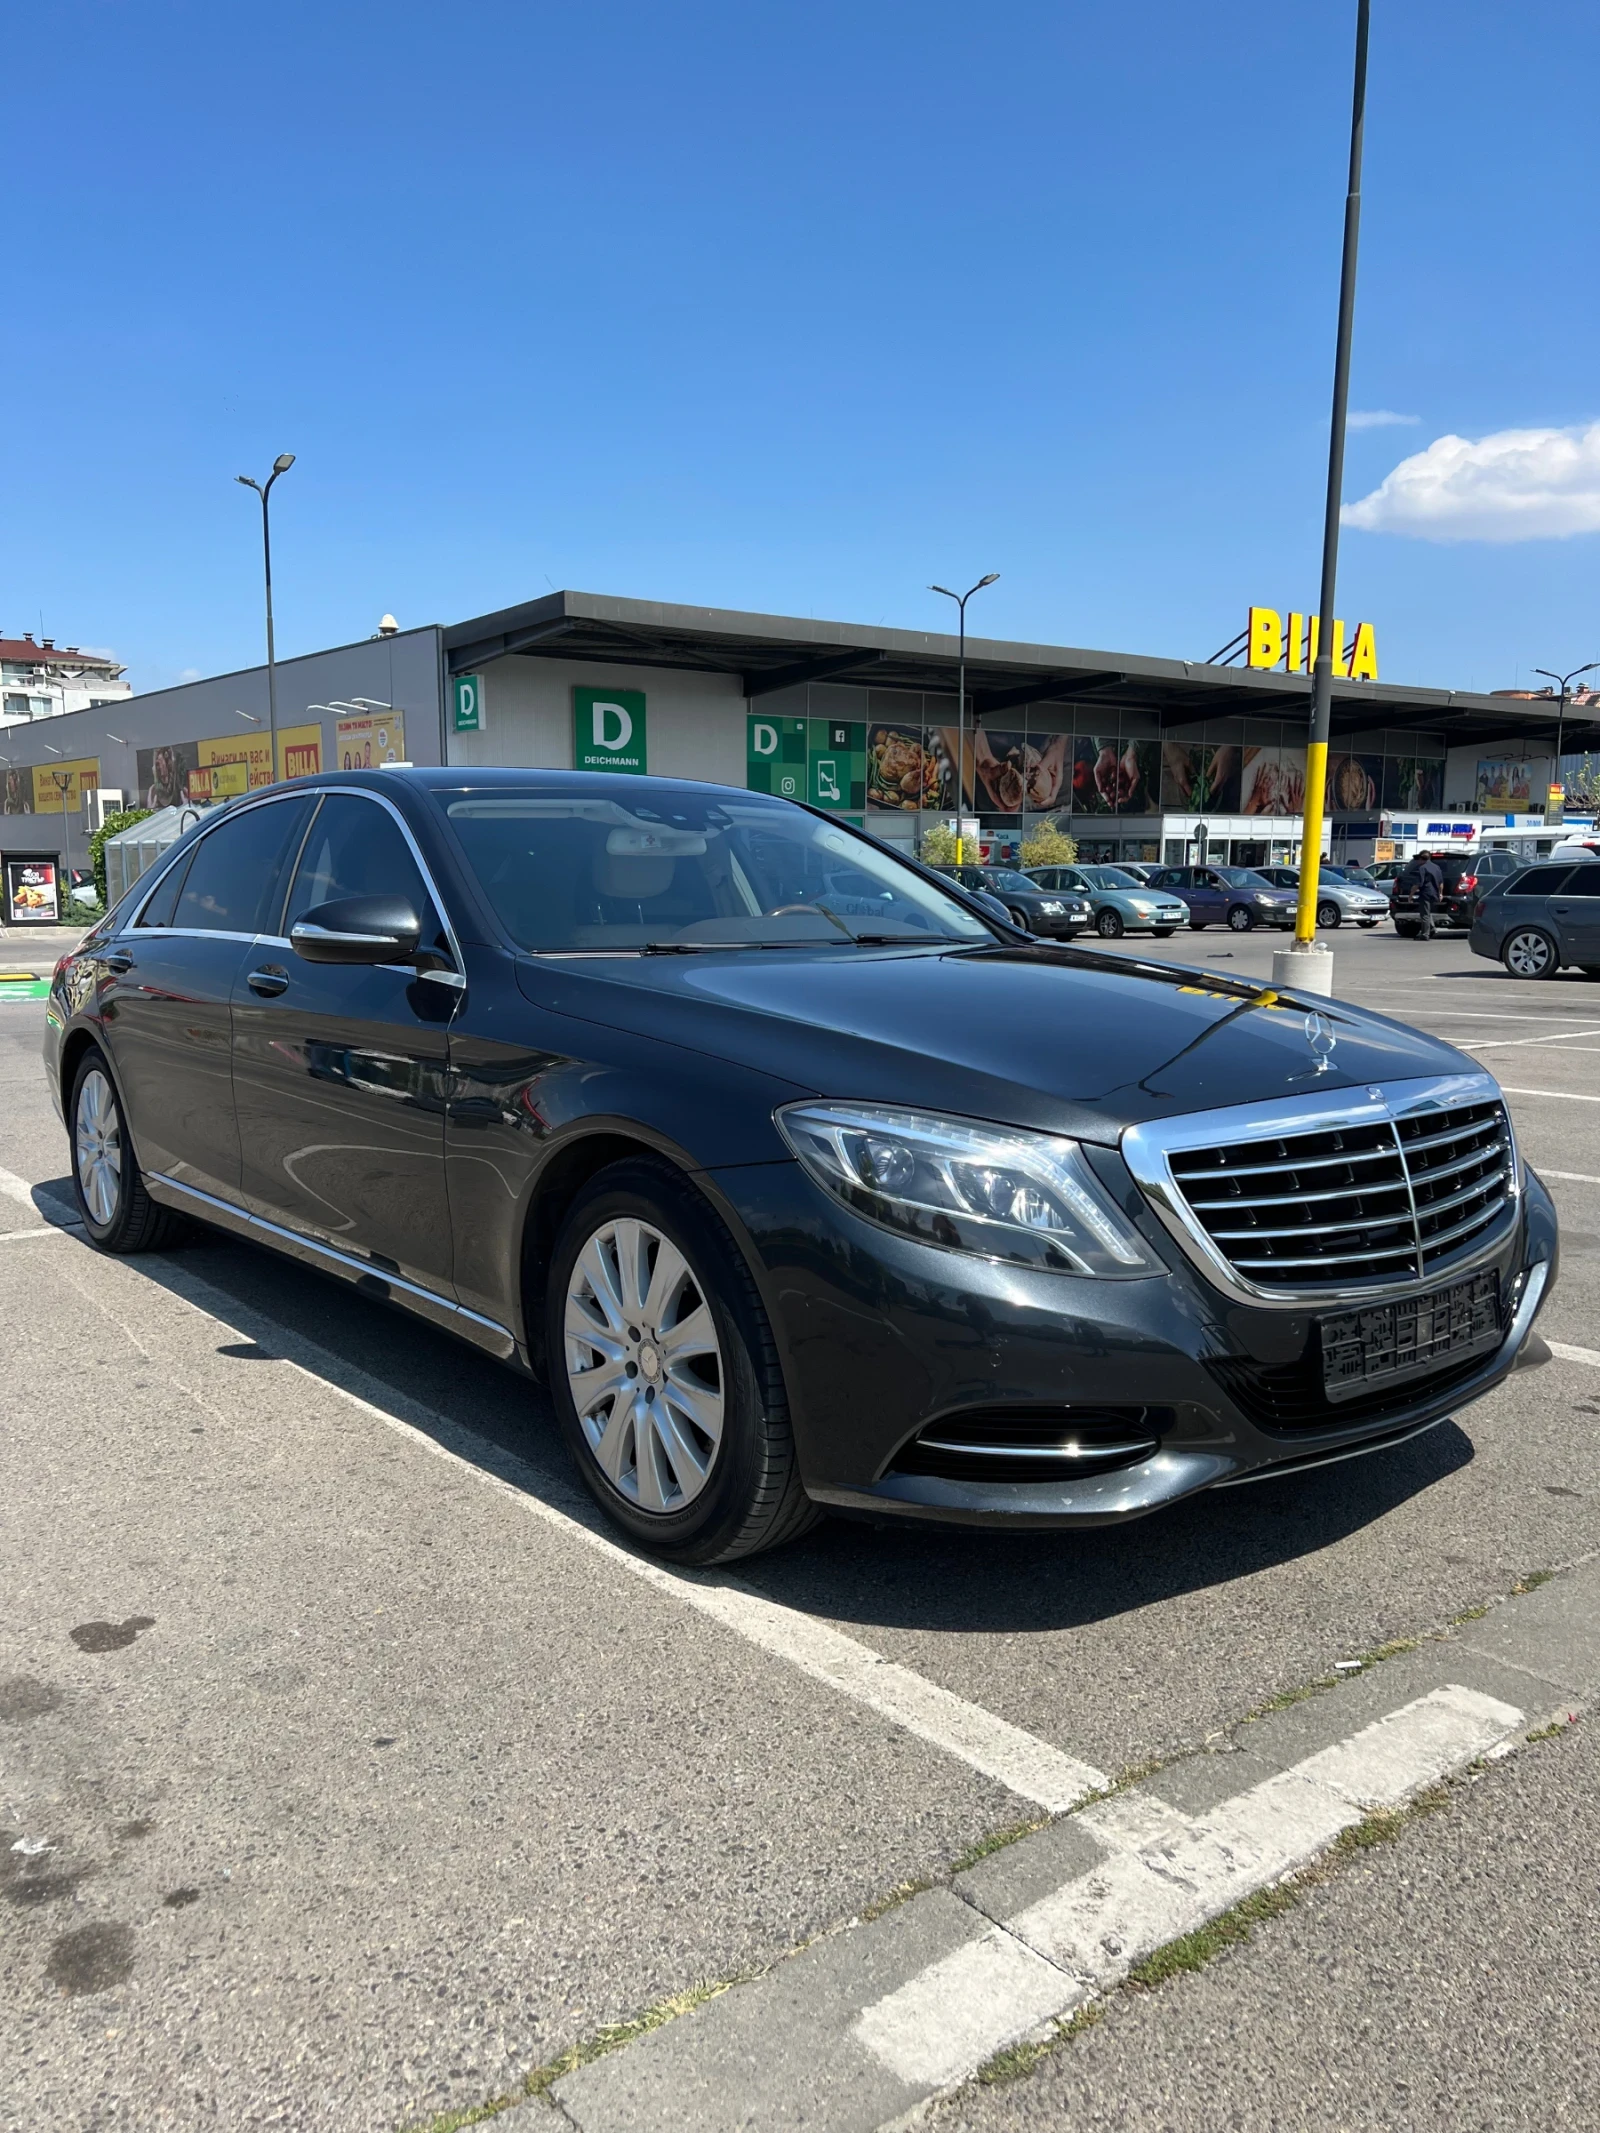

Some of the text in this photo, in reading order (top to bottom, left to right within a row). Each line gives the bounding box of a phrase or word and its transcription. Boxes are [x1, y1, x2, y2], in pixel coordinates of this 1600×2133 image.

[460, 684, 474, 716] D
[593, 701, 633, 751] D
[754, 723, 778, 755] D
[250, 750, 263, 764] вас
[287, 750, 318, 777] BILLA
[584, 755, 639, 766] DEICHMANN
[189, 771, 211, 792] BILLA
